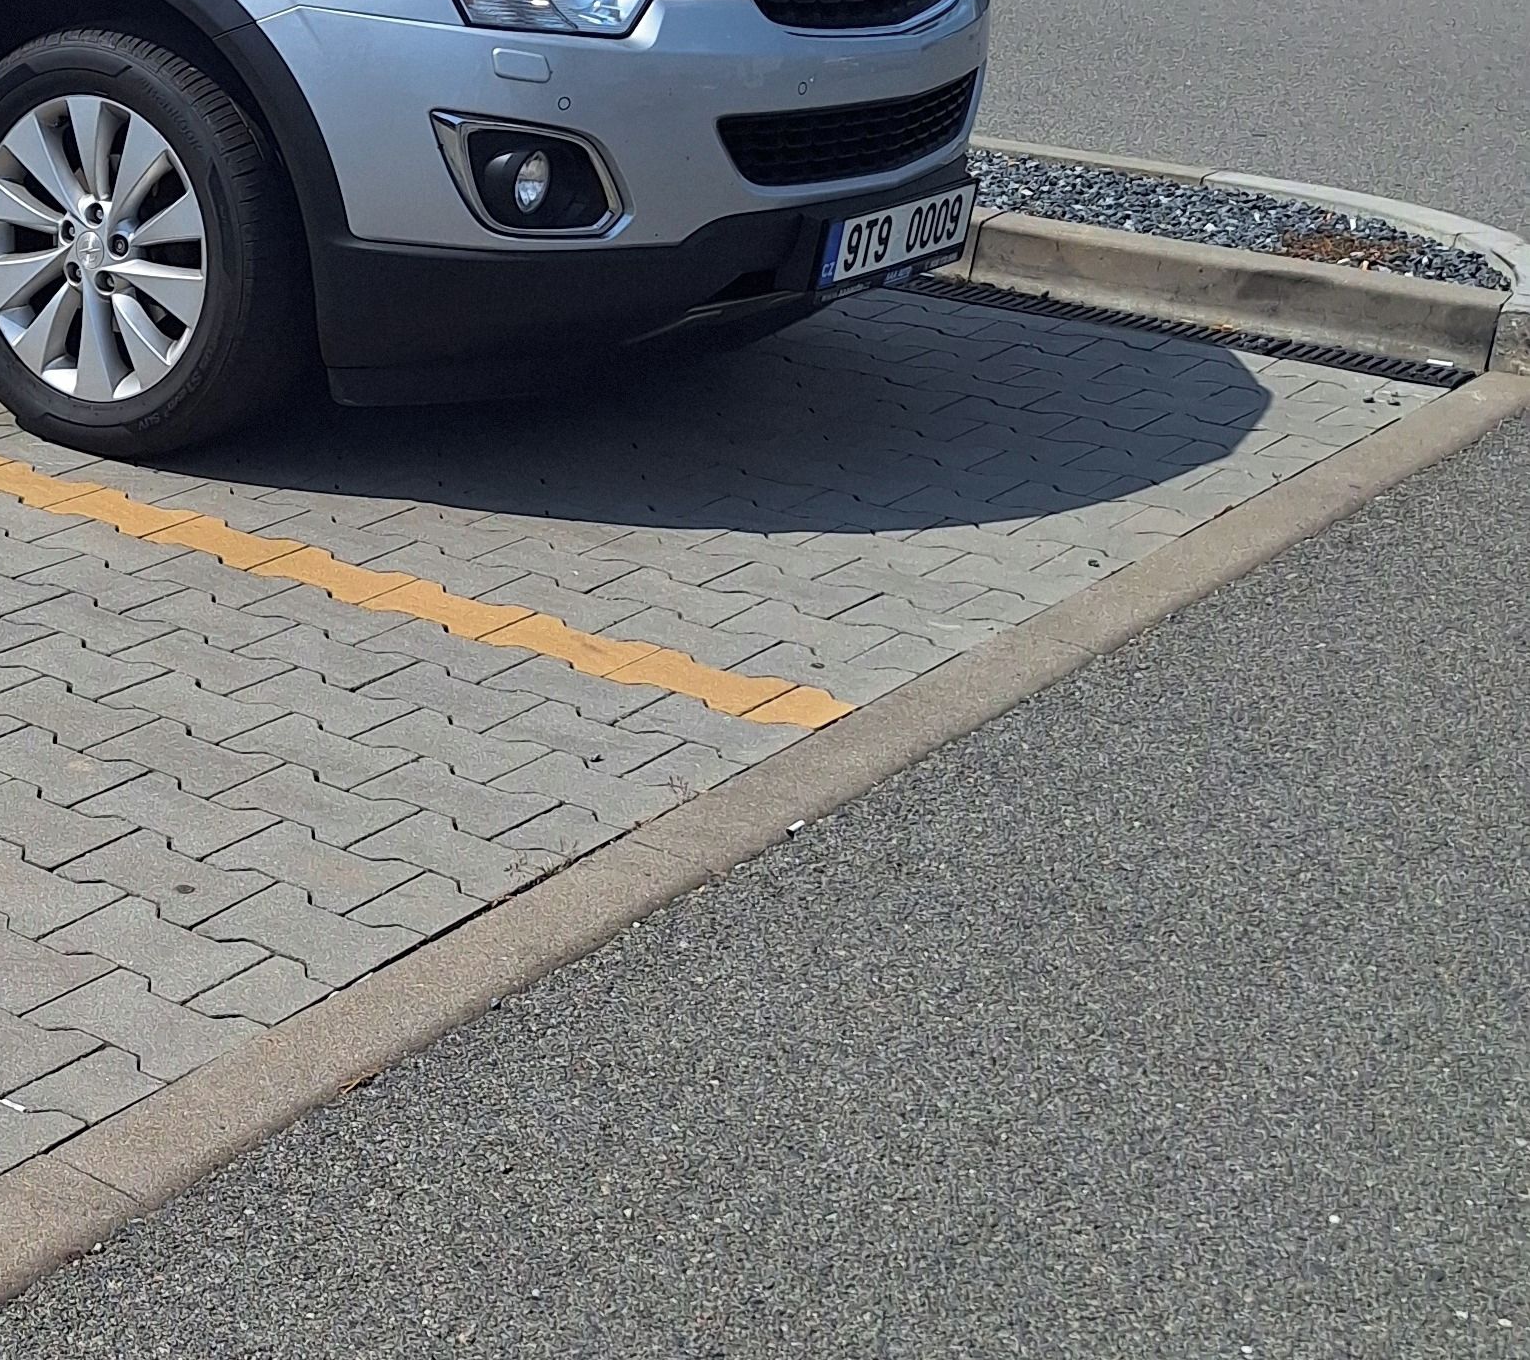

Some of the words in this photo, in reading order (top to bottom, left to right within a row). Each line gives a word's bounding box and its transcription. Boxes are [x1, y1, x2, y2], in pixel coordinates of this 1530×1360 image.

[843, 214, 893, 273] 9T9
[905, 193, 964, 254] 0009
[821, 261, 836, 279] CZ
